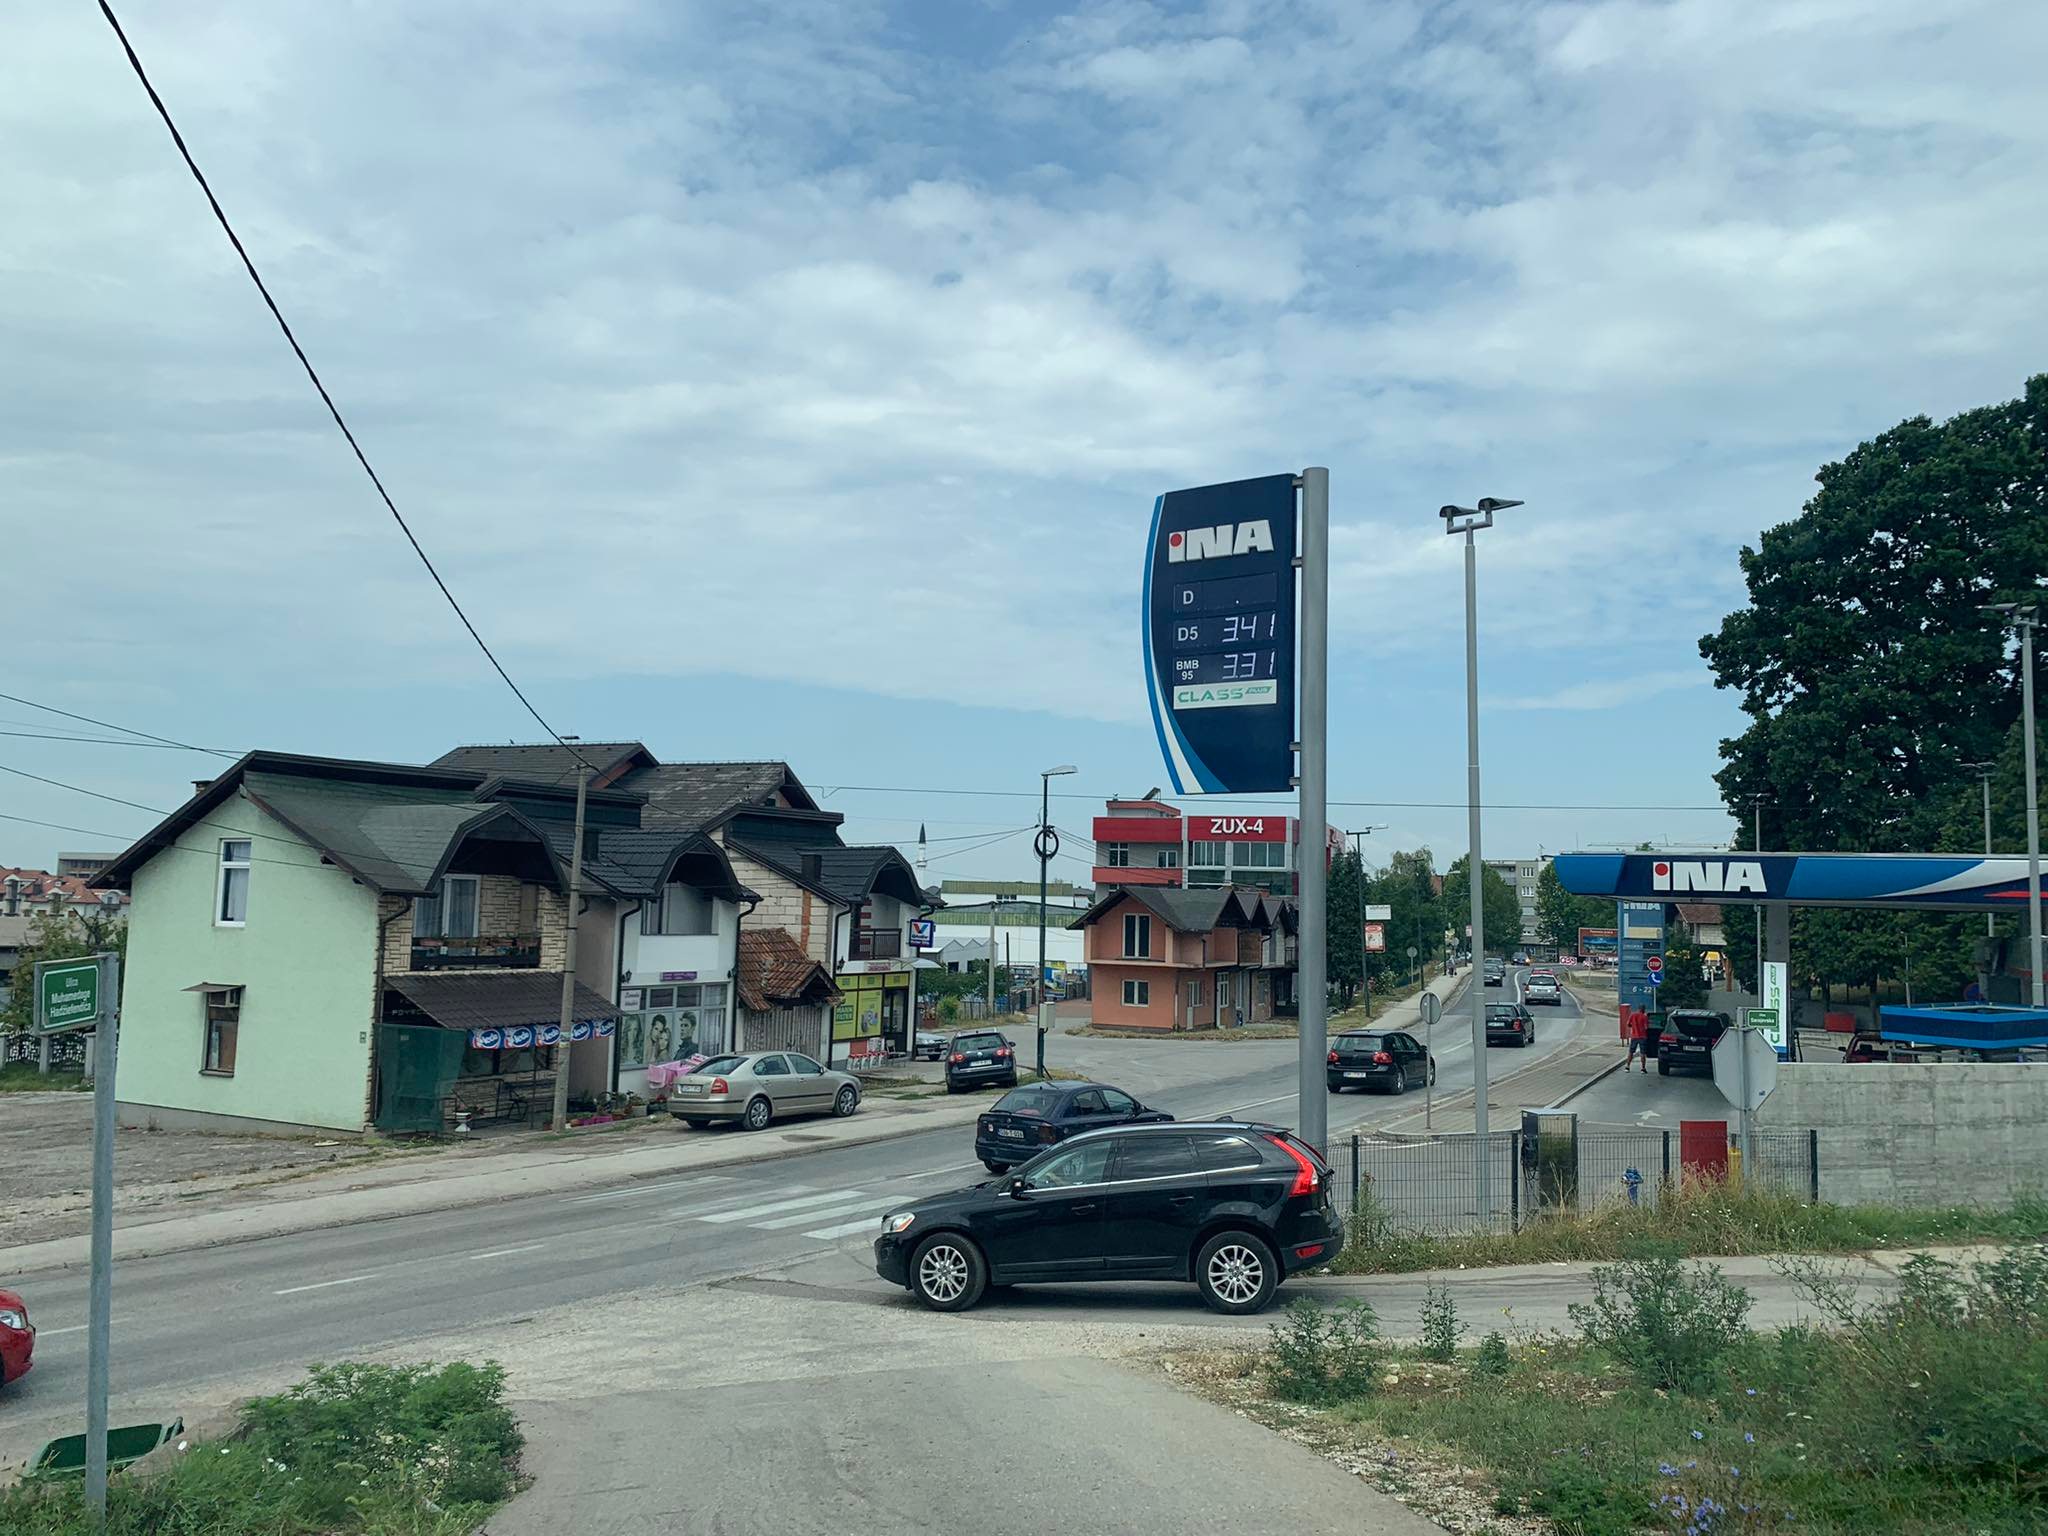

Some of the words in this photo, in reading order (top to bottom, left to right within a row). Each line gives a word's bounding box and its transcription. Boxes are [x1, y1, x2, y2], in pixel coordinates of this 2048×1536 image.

[1182, 590, 1194, 605] D
[1177, 626, 1198, 641] D5
[1175, 658, 1199, 671] BMB
[1181, 670, 1193, 681] 95
[1177, 688, 1243, 703] CLASS
[1210, 818, 1264, 834] ZUX-4
